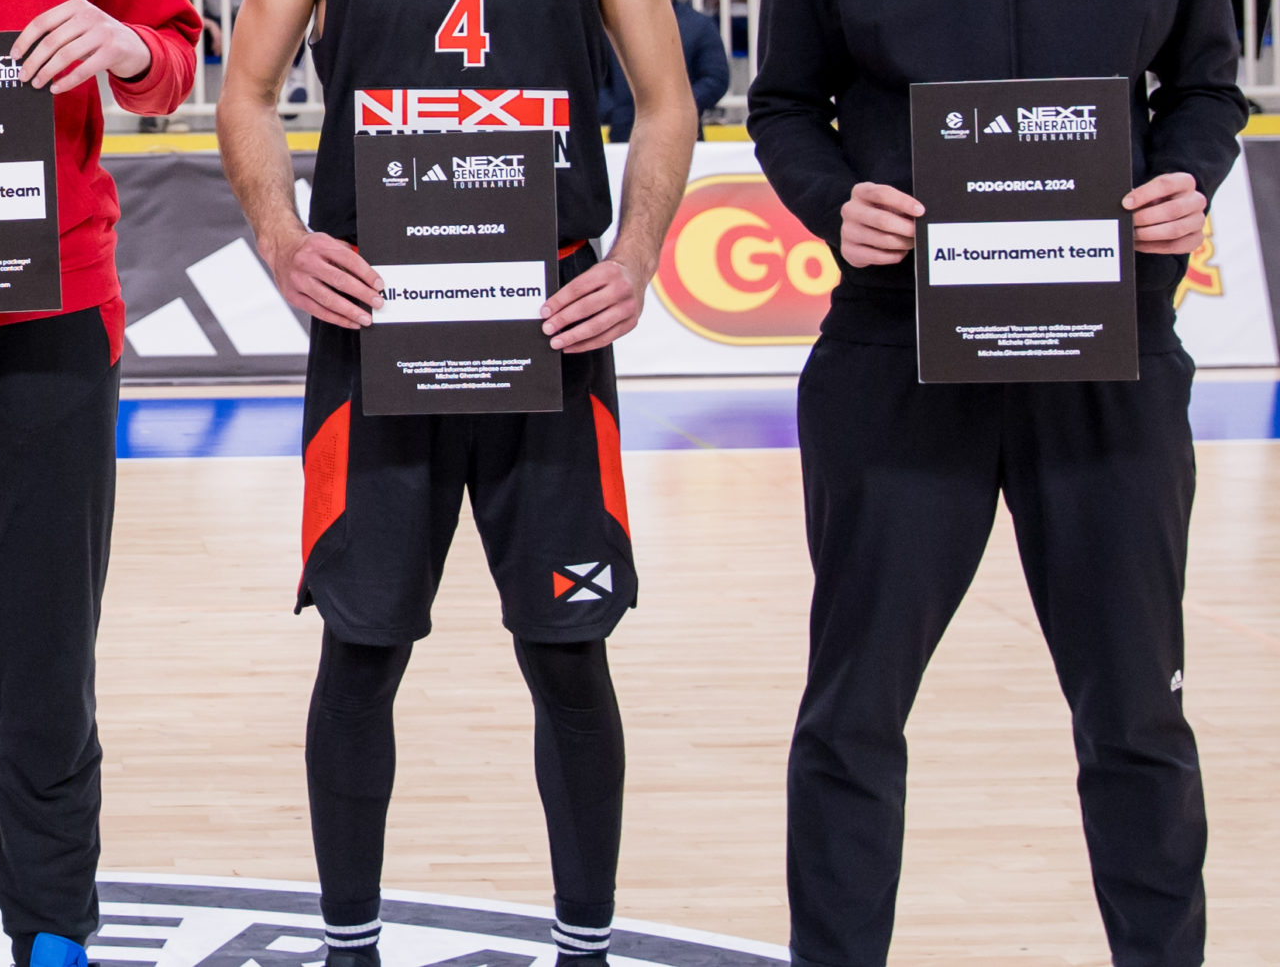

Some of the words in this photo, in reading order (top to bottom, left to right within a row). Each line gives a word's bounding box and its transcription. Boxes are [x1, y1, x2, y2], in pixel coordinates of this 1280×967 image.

[354, 89, 569, 126] NEXT
[1017, 105, 1096, 119] NEXT
[1019, 119, 1096, 132] GENERATION
[1018, 132, 1097, 142] TOURNAMENT
[452, 154, 524, 168] NEXT
[453, 167, 524, 179] GENERATION
[0, 185, 40, 197] team
[453, 180, 525, 189] TOURNAMENT
[967, 180, 1043, 192] PODGORICA
[1044, 179, 1075, 190] 2024
[406, 224, 476, 236] PODGORICA
[477, 223, 505, 234] 2024
[933, 245, 1064, 260] All-tournament
[1068, 245, 1114, 258] team
[499, 285, 541, 297] team
